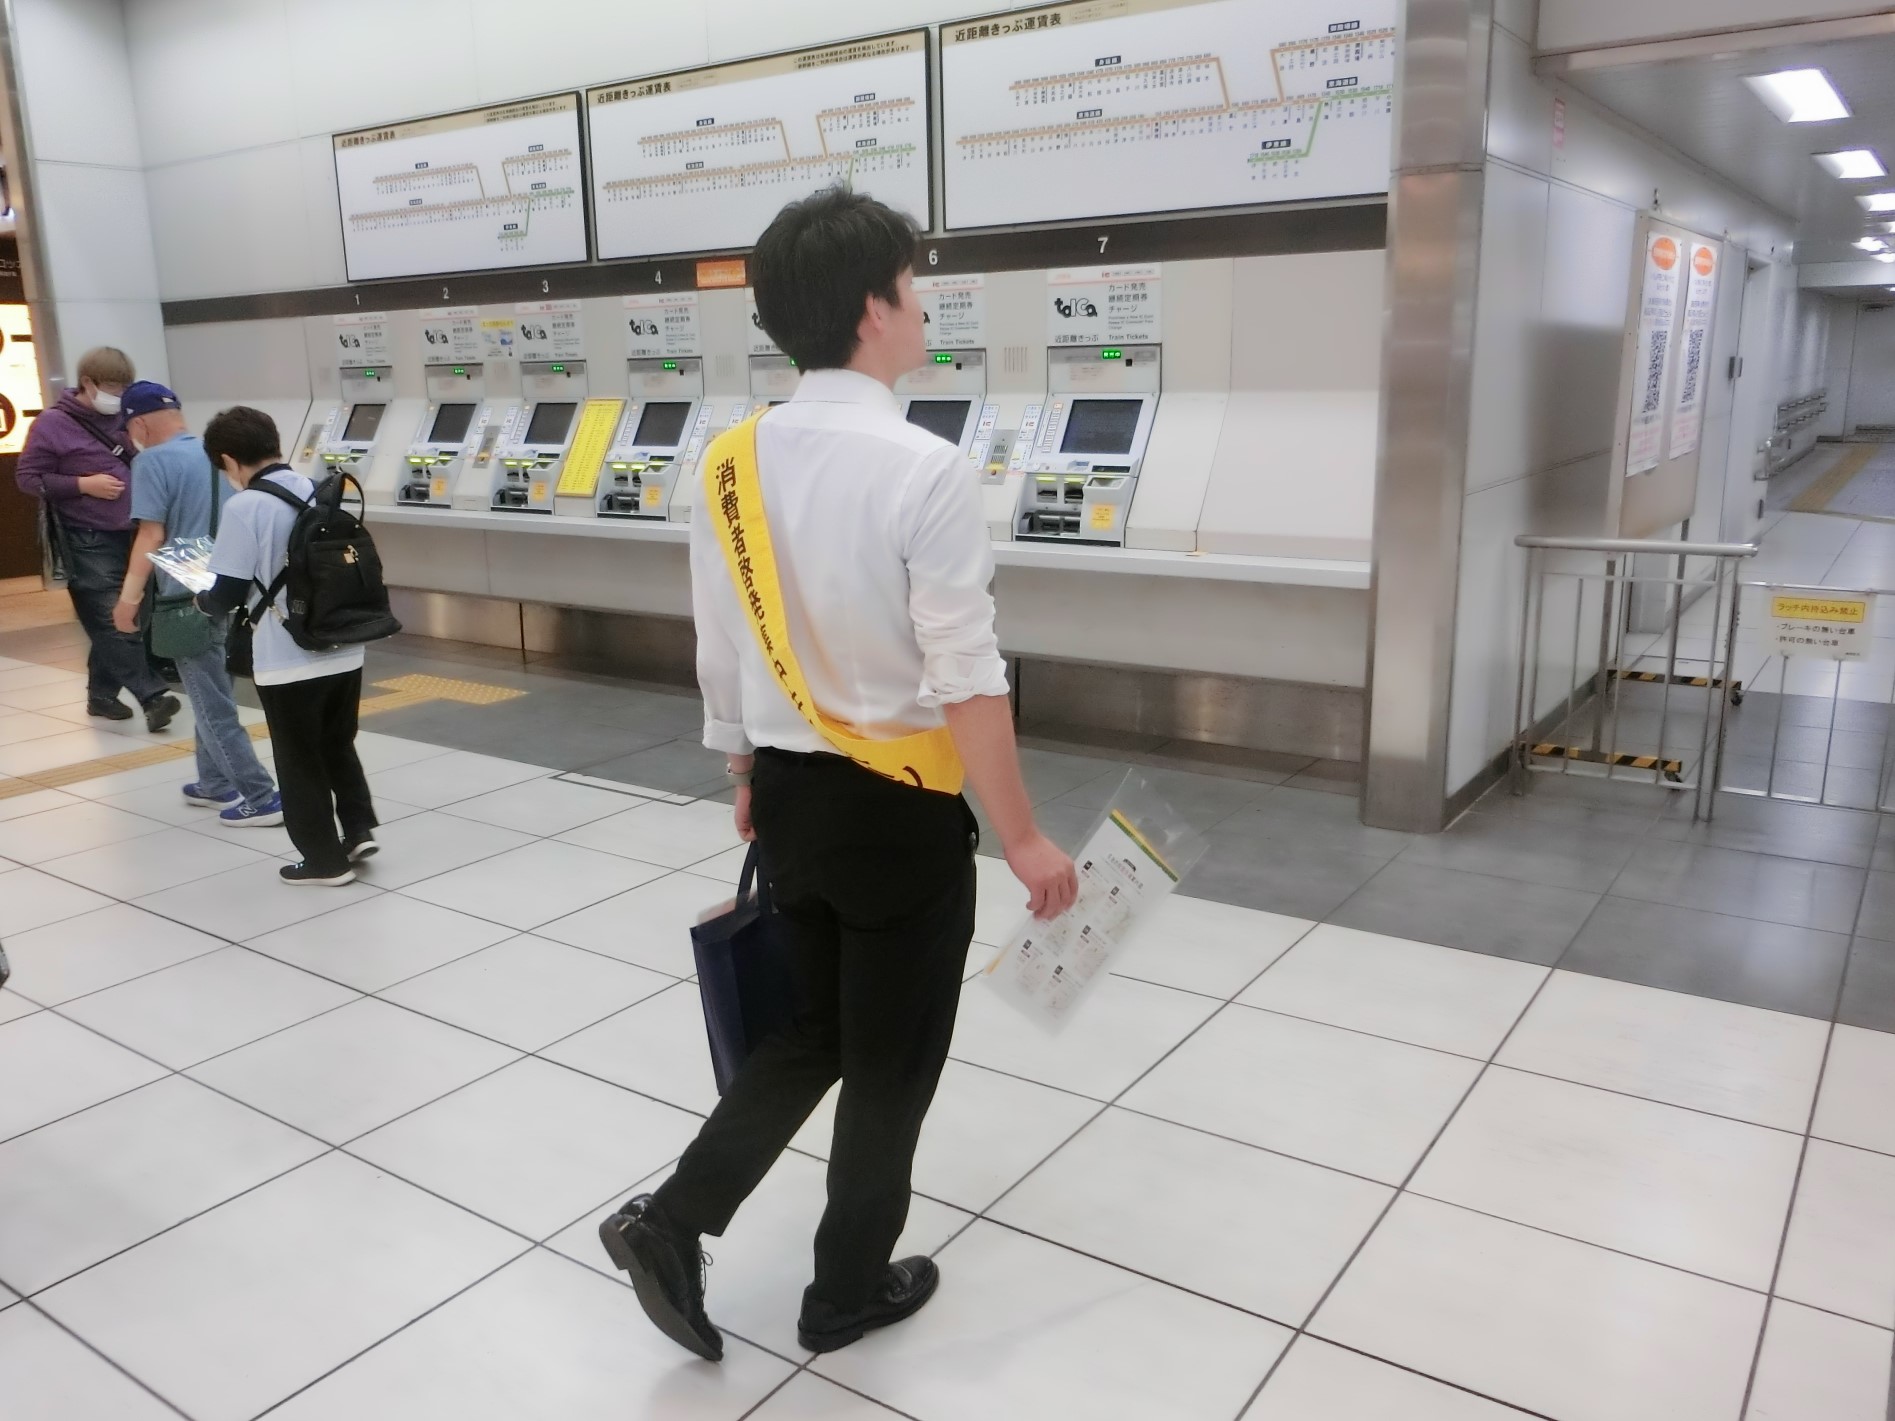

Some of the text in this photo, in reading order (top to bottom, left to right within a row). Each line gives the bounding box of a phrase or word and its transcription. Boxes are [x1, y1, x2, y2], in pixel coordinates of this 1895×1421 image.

[955, 13, 1062, 42] 近距離きっぷ運賃表
[598, 81, 671, 103] 近距離きっぷ運賃表
[1097, 237, 1108, 253] 7
[928, 249, 938, 265] 6
[655, 270, 662, 284] 4
[543, 280, 549, 292] 3
[1109, 282, 1146, 292] カード発売
[443, 287, 449, 299] 2
[939, 292, 972, 300] カード発売
[1108, 293, 1147, 303] 継続定期券
[355, 294, 360, 305] 1
[1108, 304, 1137, 313] チャージ
[939, 311, 965, 320] チャージ
[1055, 334, 1099, 343] 近距離きっぷ
[1776, 602, 1859, 616] ラッチ内持込み禁止
